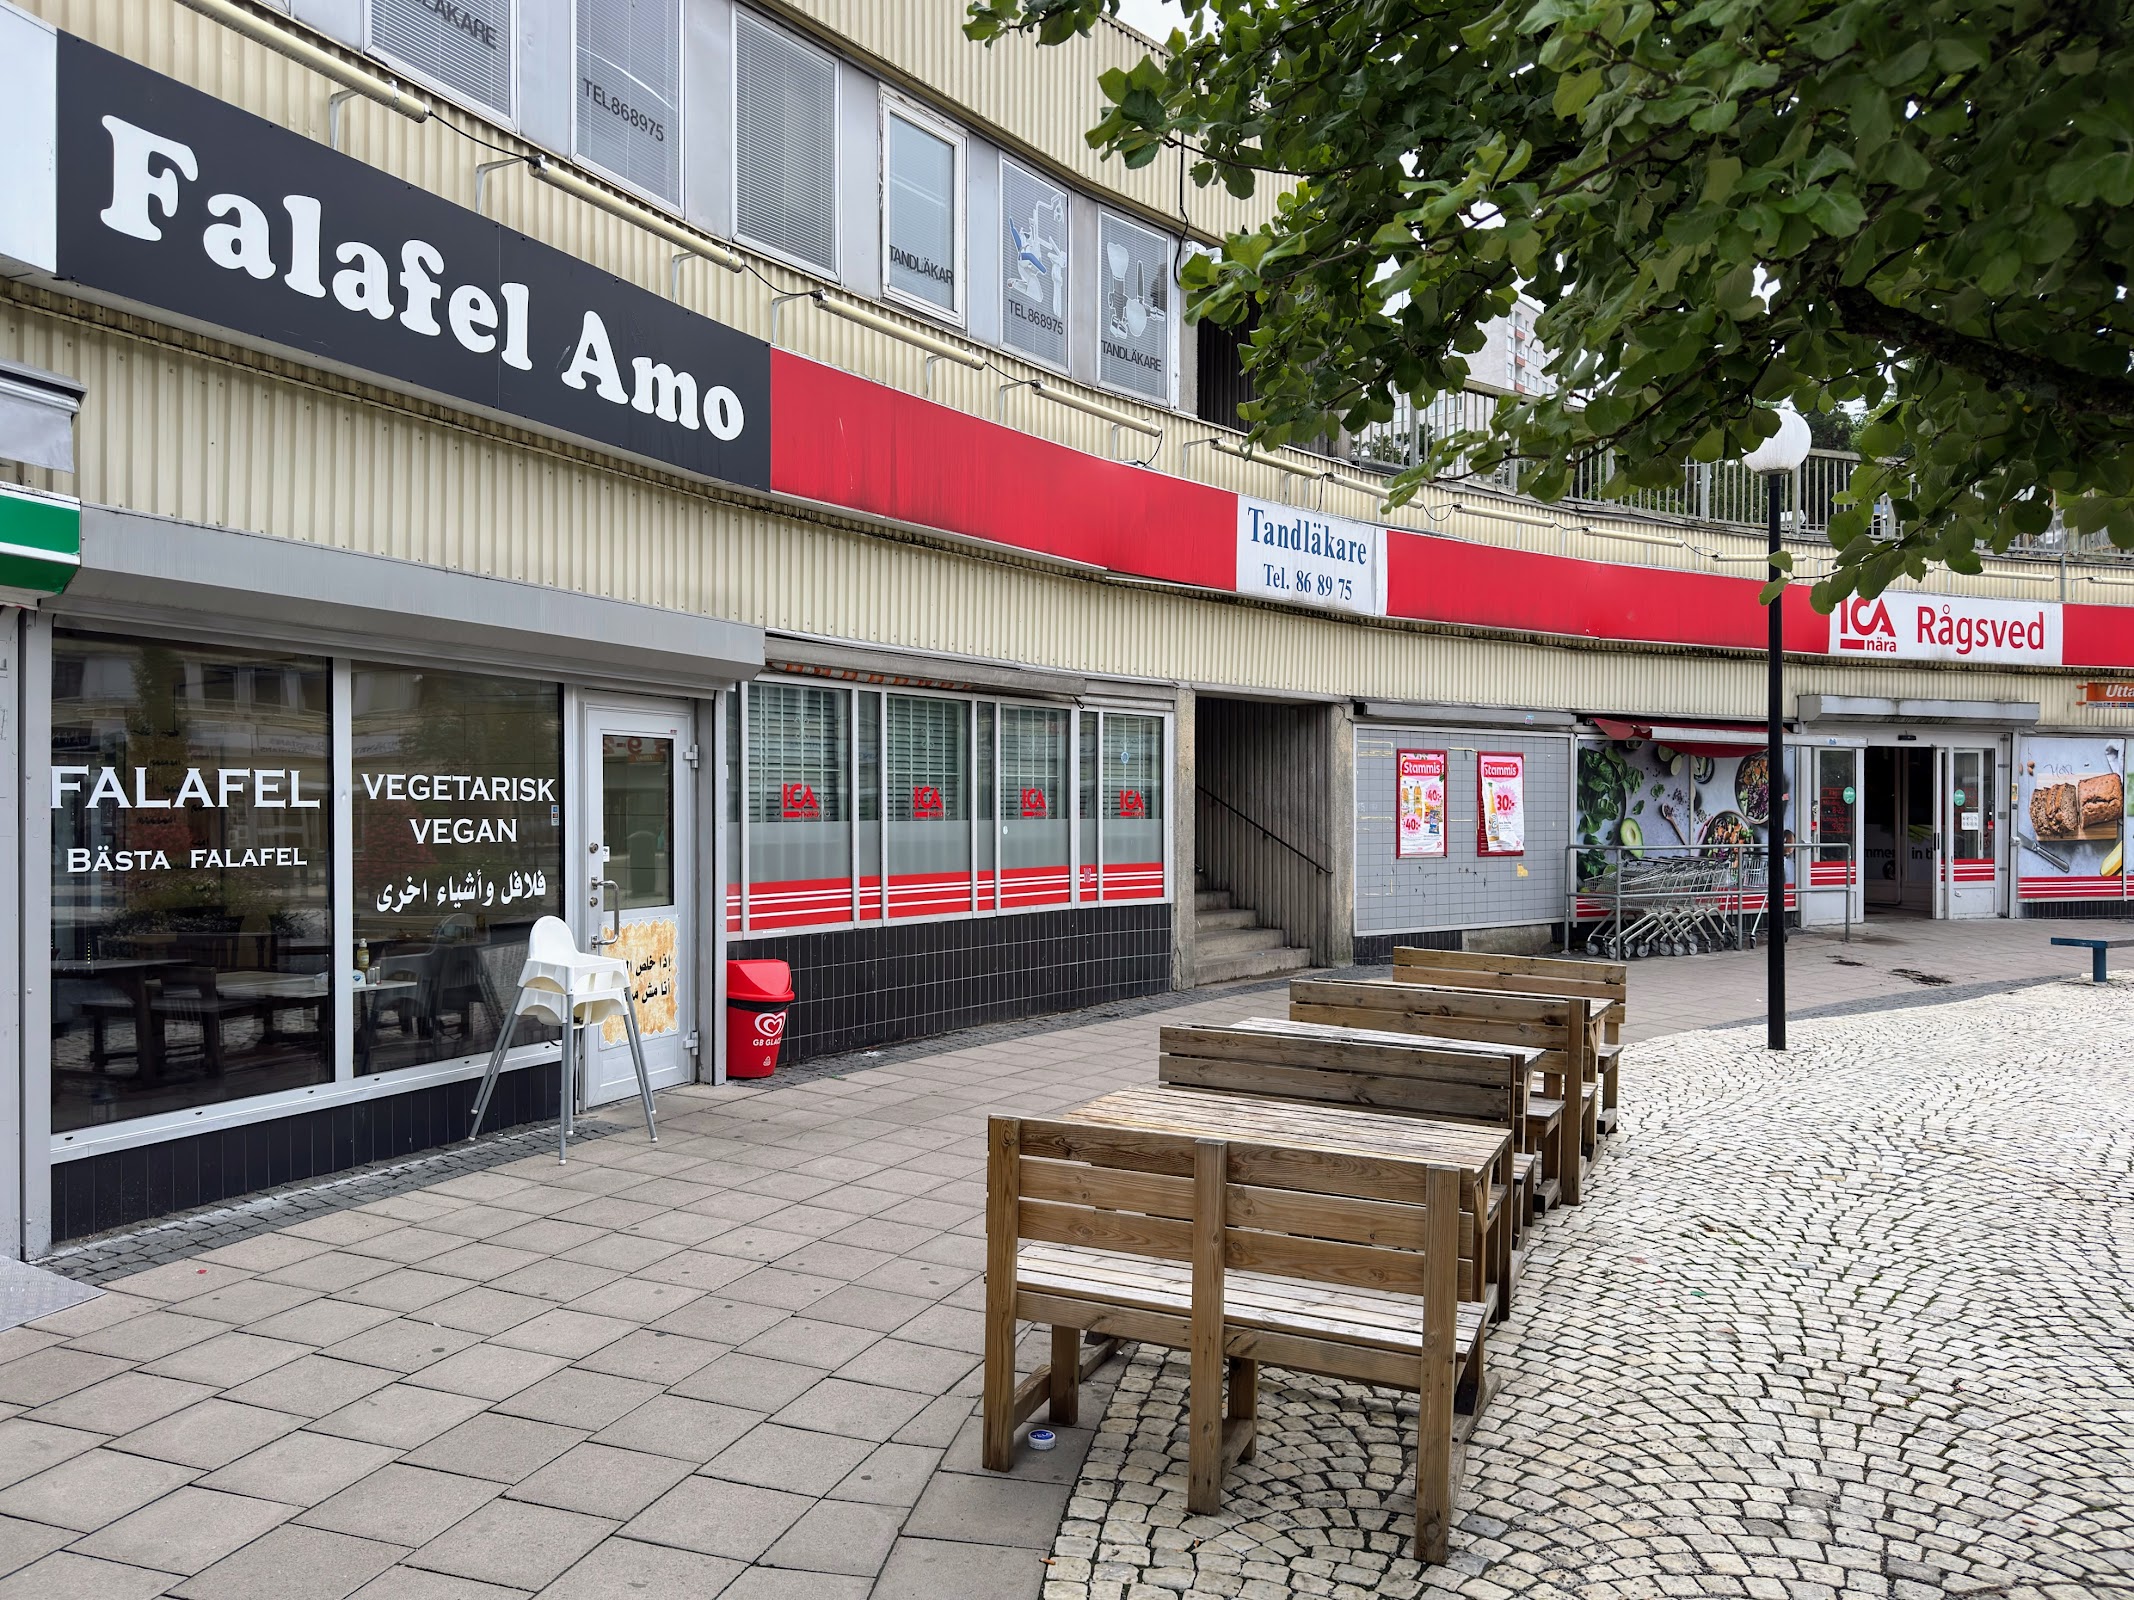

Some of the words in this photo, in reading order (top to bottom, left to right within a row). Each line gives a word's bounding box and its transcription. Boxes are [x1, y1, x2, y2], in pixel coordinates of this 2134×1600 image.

[101, 114, 533, 371] Falafel
[561, 310, 746, 442] Amo
[1100, 339, 1162, 373] TANDLÄKARE
[1247, 506, 1367, 566] Tandläkare
[1263, 563, 1290, 590] Tel.
[1296, 569, 1312, 594] 86
[1317, 573, 1333, 597] 89
[1338, 578, 1352, 601] 75
[1840, 596, 1897, 637] ICA
[1917, 604, 2044, 655] Rågsved
[1867, 636, 1897, 652] nära
[1403, 761, 1441, 774] Stammis
[50, 764, 320, 810] FALAFEL
[361, 773, 556, 802] VEGETARISK
[782, 783, 819, 809] ICA
[914, 785, 943, 809] ICA
[1021, 787, 1047, 809] ICA
[1119, 789, 1144, 810] ICA
[1496, 794, 1515, 811] 30:-
[409, 818, 517, 844] VEGAN
[67, 845, 171, 873] BÄSTA
[190, 847, 307, 868] FALAFEL
[376, 875, 428, 913] اخرى
[501, 869, 547, 905] فلافل
[752, 1038, 765, 1047] GB
